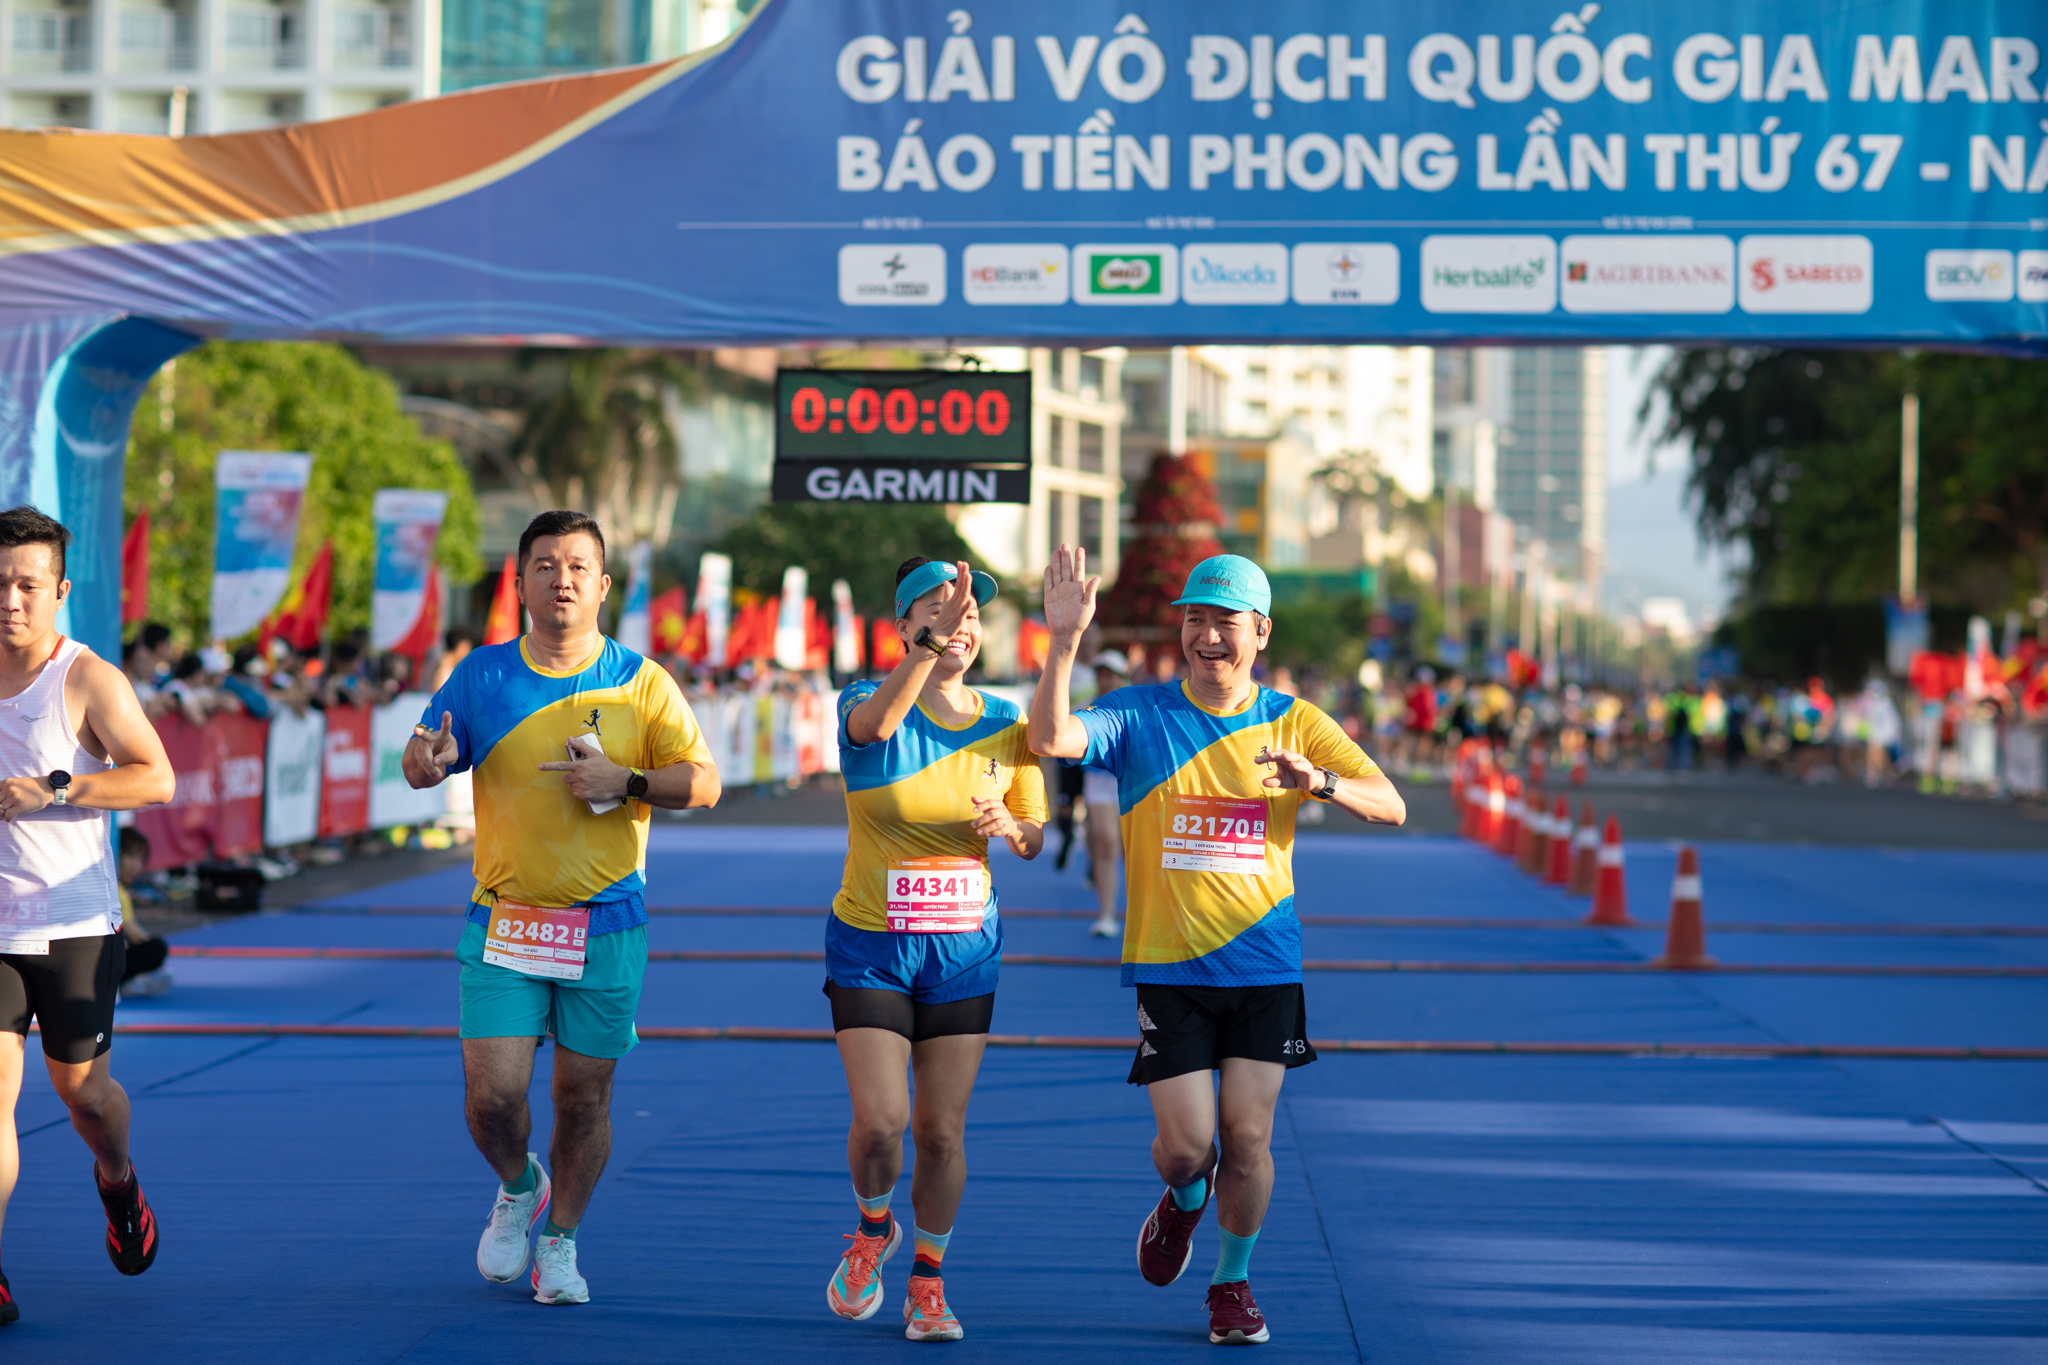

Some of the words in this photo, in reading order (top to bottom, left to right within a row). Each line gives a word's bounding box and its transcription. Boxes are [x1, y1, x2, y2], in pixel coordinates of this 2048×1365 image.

[836, 10, 1014, 102] GIẢI
[1036, 15, 1166, 102] VÔ
[1186, 34, 1387, 119] ĐỊCH
[1407, 3, 1652, 108] QUỐC
[1673, 34, 1829, 102] GIA
[1849, 35, 2048, 103] MAR
[837, 120, 996, 192] BÁO
[1012, 109, 1170, 191] TIỀN
[1190, 133, 1459, 192] PHONG
[1477, 108, 1627, 191] LẦN
[1645, 117, 1802, 191] THỨ
[1815, 134, 1903, 192] 67
[1920, 162, 1950, 181] -
[1433, 264, 1536, 288] Herbalife
[1595, 262, 1728, 284] AGRIBANK
[1784, 264, 1864, 283] SABECO
[791, 387, 1011, 435] 0:00:00
[806, 466, 997, 501] GARMIN
[1200, 576, 1231, 588] HOKA
[1172, 814, 1250, 839] 82170
[896, 877, 968, 896] 84341
[0, 901, 31, 920] 75
[495, 918, 569, 944] 82482
